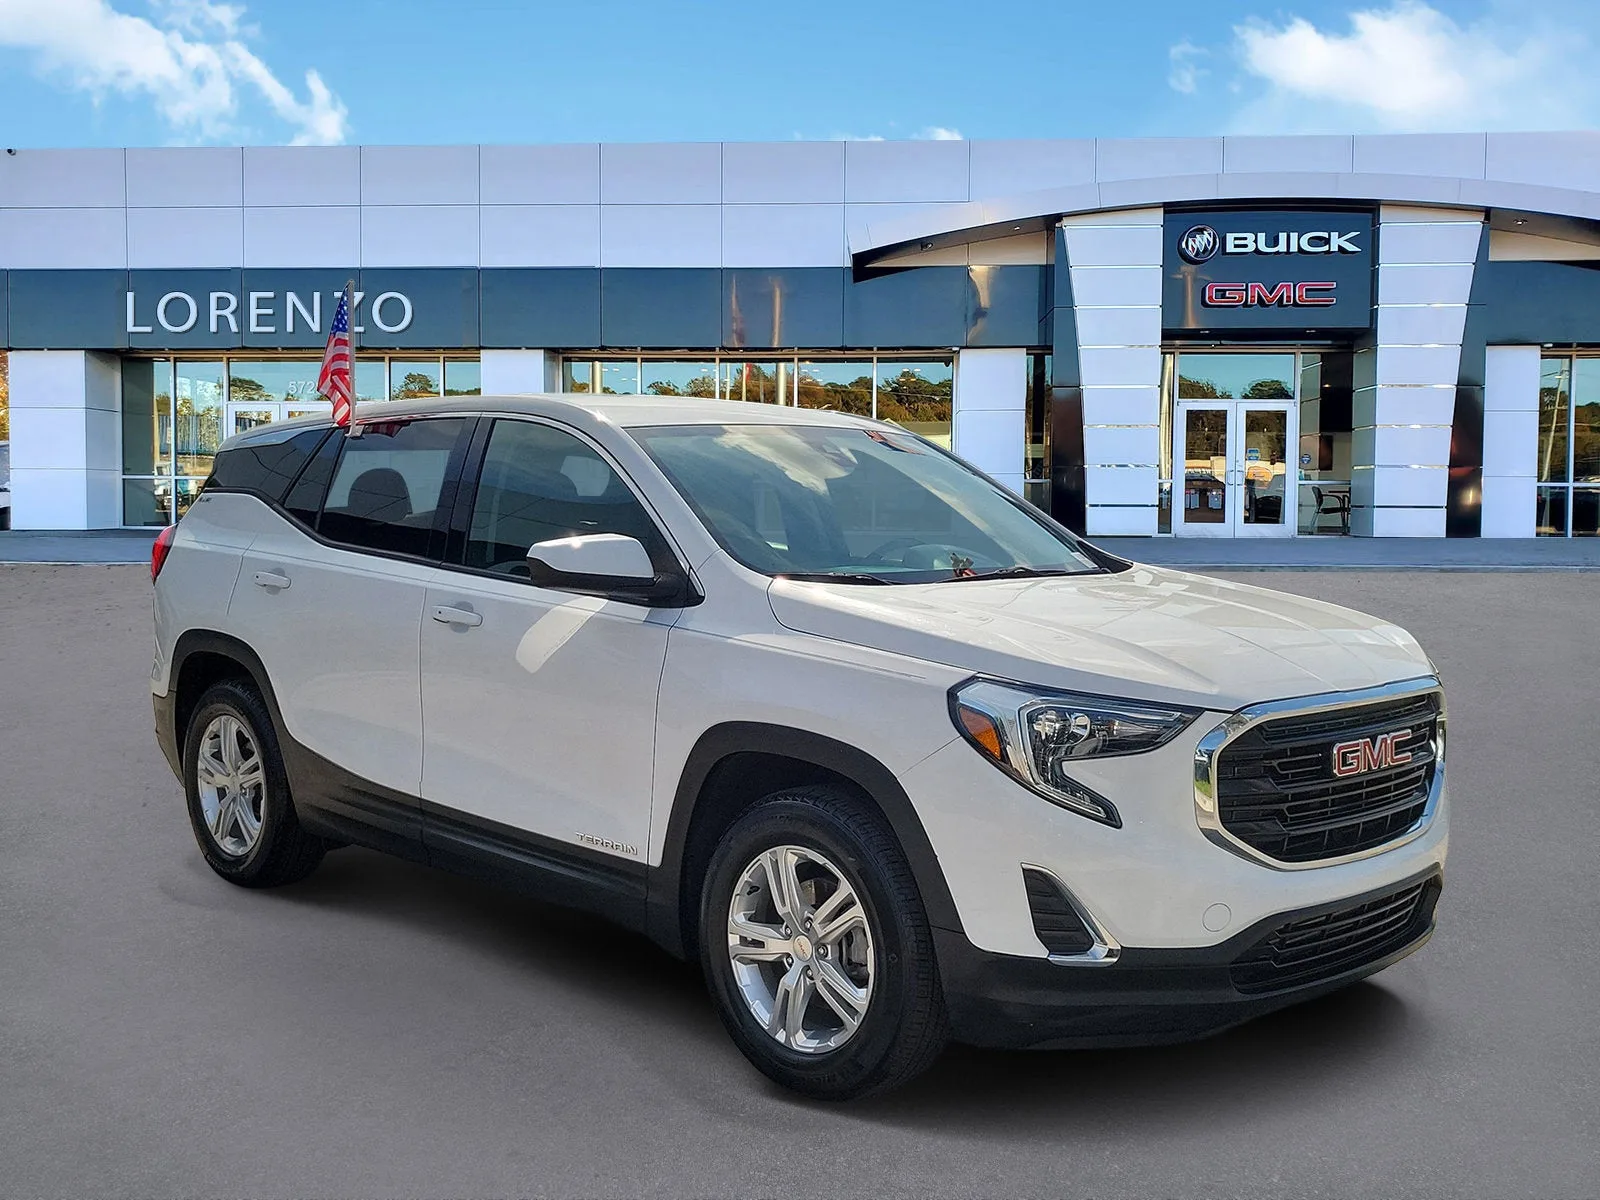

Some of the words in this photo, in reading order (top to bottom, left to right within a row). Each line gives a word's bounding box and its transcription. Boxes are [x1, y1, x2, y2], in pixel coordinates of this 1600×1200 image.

[1226, 231, 1362, 253] BUICK
[1205, 281, 1337, 305] GMC
[287, 381, 319, 394] 572
[1333, 728, 1412, 777] GMC
[575, 831, 638, 856] TERRAIN
